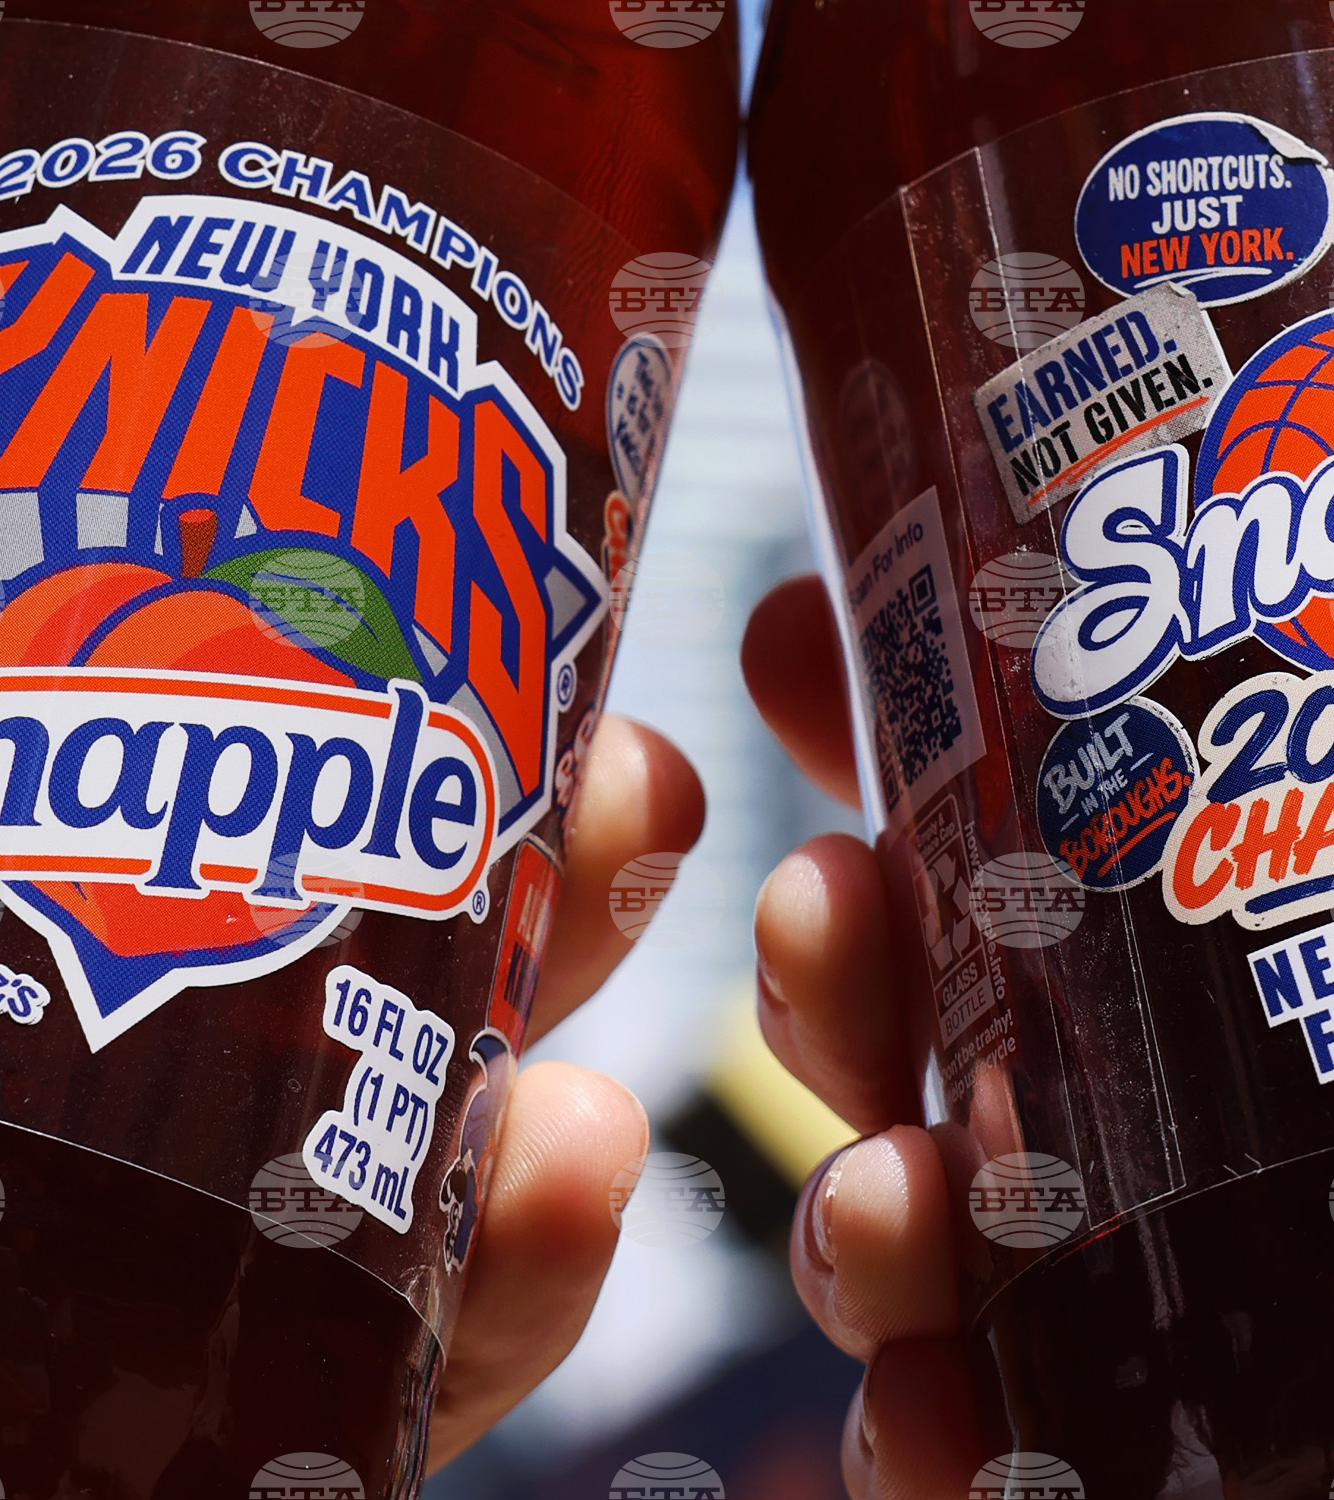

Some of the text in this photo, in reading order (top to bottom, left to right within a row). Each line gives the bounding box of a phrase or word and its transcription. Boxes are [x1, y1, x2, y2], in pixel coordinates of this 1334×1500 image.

[1108, 154, 1292, 201] NO SHORTCUTS.
[1152, 195, 1243, 234] JUST
[224, 146, 581, 405] CHAMPIONS
[1121, 226, 1294, 278] NEW YORK.
[120, 214, 461, 393] NEW YORK
[987, 310, 1178, 454] EARNED.
[1009, 420, 1080, 497] NOT
[1083, 353, 1213, 444] GIVEN.
[873, 547, 893, 581] For
[895, 522, 924, 557] Info
[1043, 712, 1133, 814] BUILT
[1081, 768, 1128, 816] IN THE
[1059, 756, 1191, 880] BOROUGHS.
[333, 978, 448, 1086] 16 FL OZ
[942, 962, 977, 1007] GLASS
[946, 990, 985, 1038] BOTTLE
[959, 1036, 975, 1064] be
[974, 1009, 1014, 1049] trashy!
[354, 1065, 428, 1165] (1 PT)
[314, 1124, 408, 1220] 473 mL
